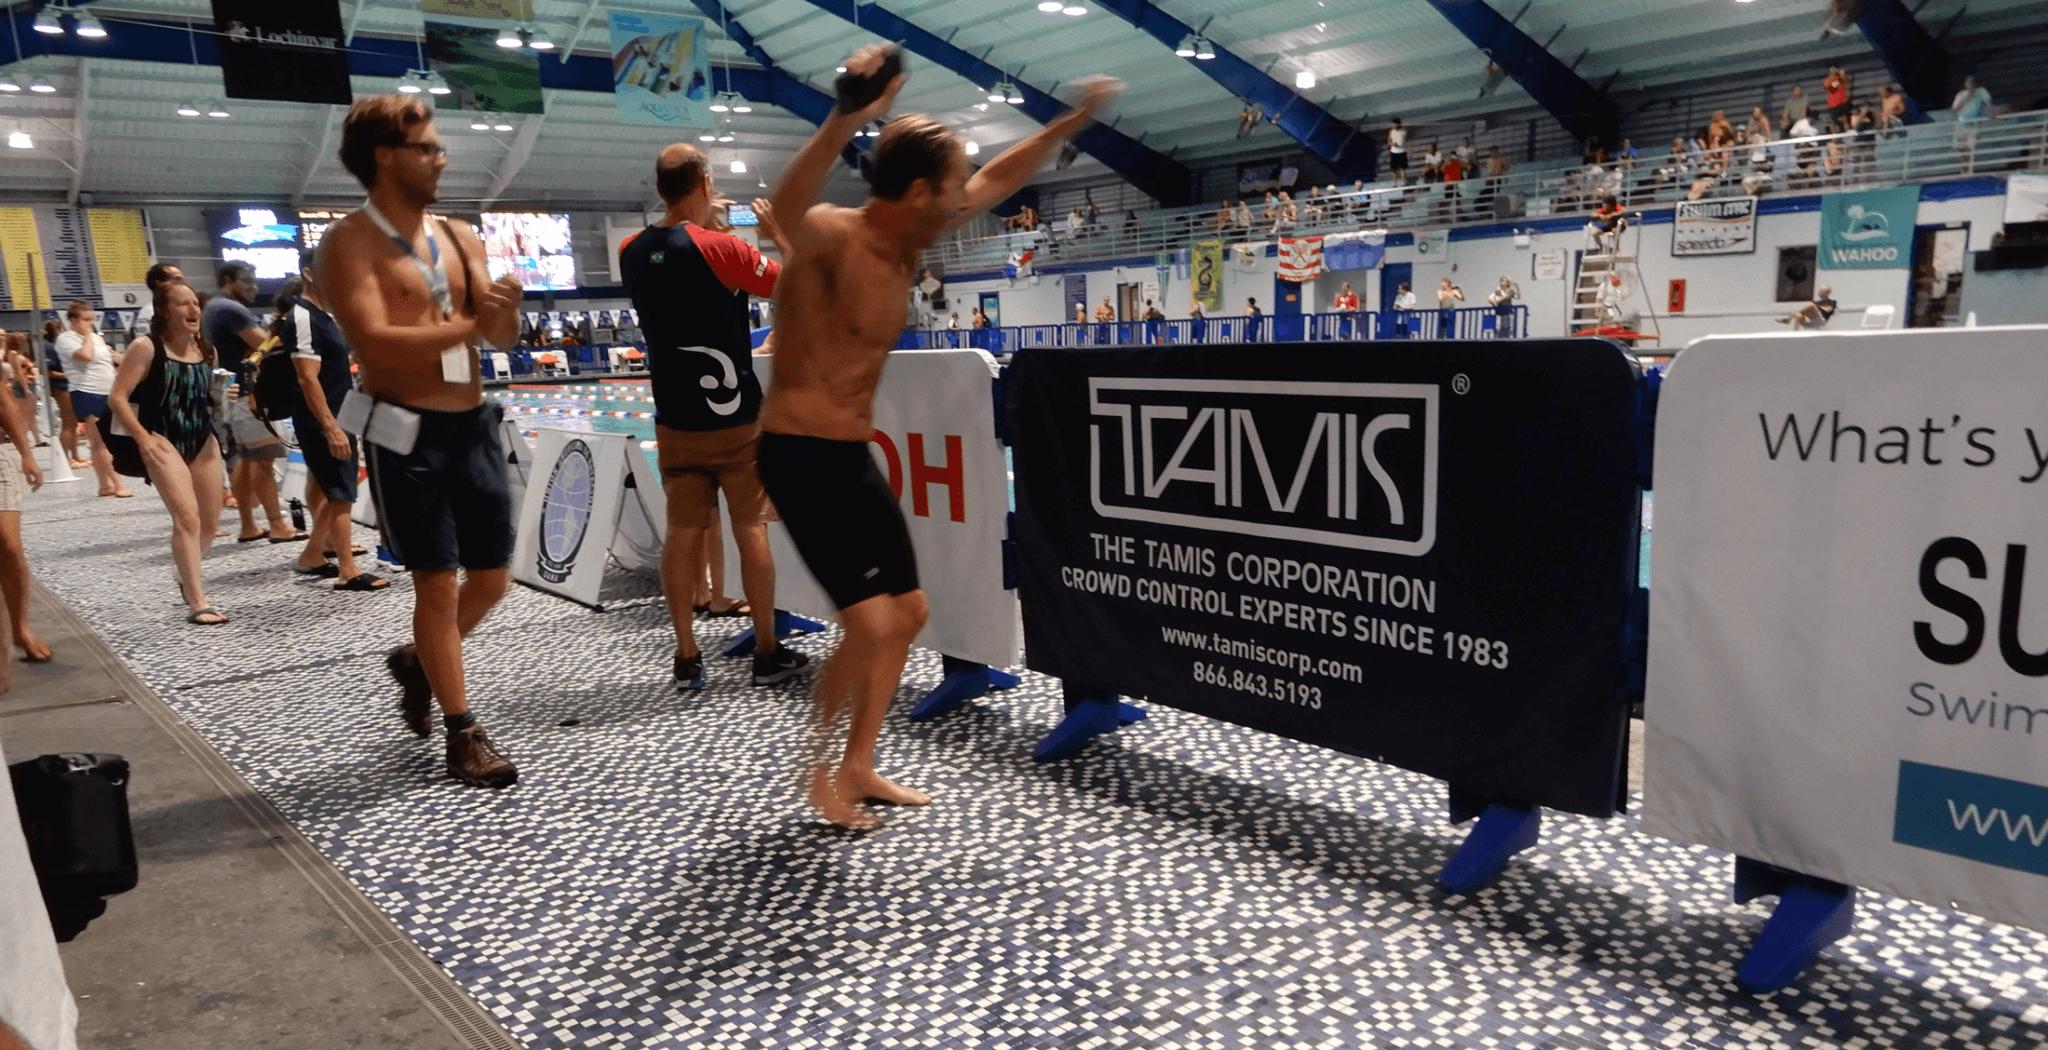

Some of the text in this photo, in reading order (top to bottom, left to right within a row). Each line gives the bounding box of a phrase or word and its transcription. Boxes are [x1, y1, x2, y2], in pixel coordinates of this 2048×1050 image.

[1831, 246, 1898, 263] WAHOO
[1090, 402, 1411, 525] TAMIS
[1758, 410, 1997, 468] What's
[1089, 532, 1437, 614] THE TAMIS CORPORATION
[1061, 566, 1509, 670] CROWD CONTROL EXPERTS SINCE 1983
[1161, 625, 1363, 684] www.tamiscorp.com
[1192, 660, 1323, 711] 866.843.5193
